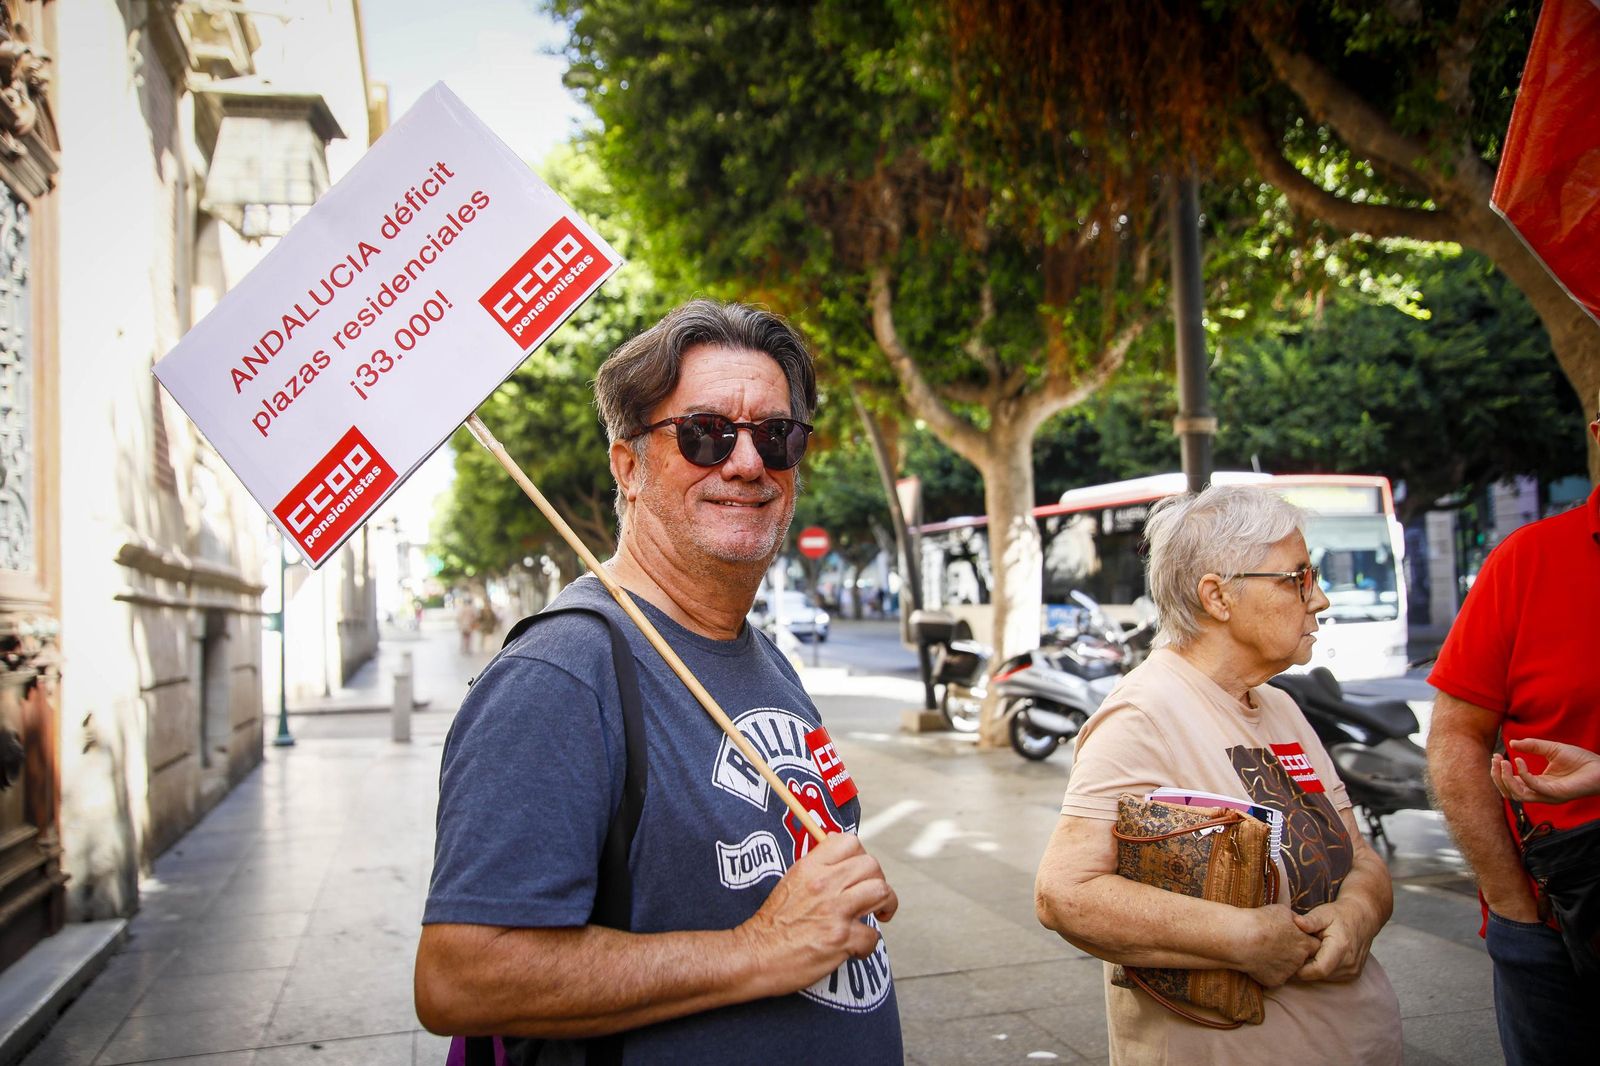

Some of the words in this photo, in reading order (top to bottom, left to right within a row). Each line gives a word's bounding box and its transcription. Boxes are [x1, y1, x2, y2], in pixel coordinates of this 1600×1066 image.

[228, 240, 382, 394] ANDALUCIA
[380, 159, 456, 241] déficit
[251, 346, 332, 438] plazas
[332, 188, 492, 352] residenciales
[493, 233, 584, 324] CCOO
[511, 252, 595, 338] pensionistas
[350, 288, 456, 401] ¡33.000!
[286, 443, 373, 535] CCOO
[303, 463, 383, 549] pensionistas
[813, 742, 842, 772] CC
[725, 843, 775, 877] TOUR
